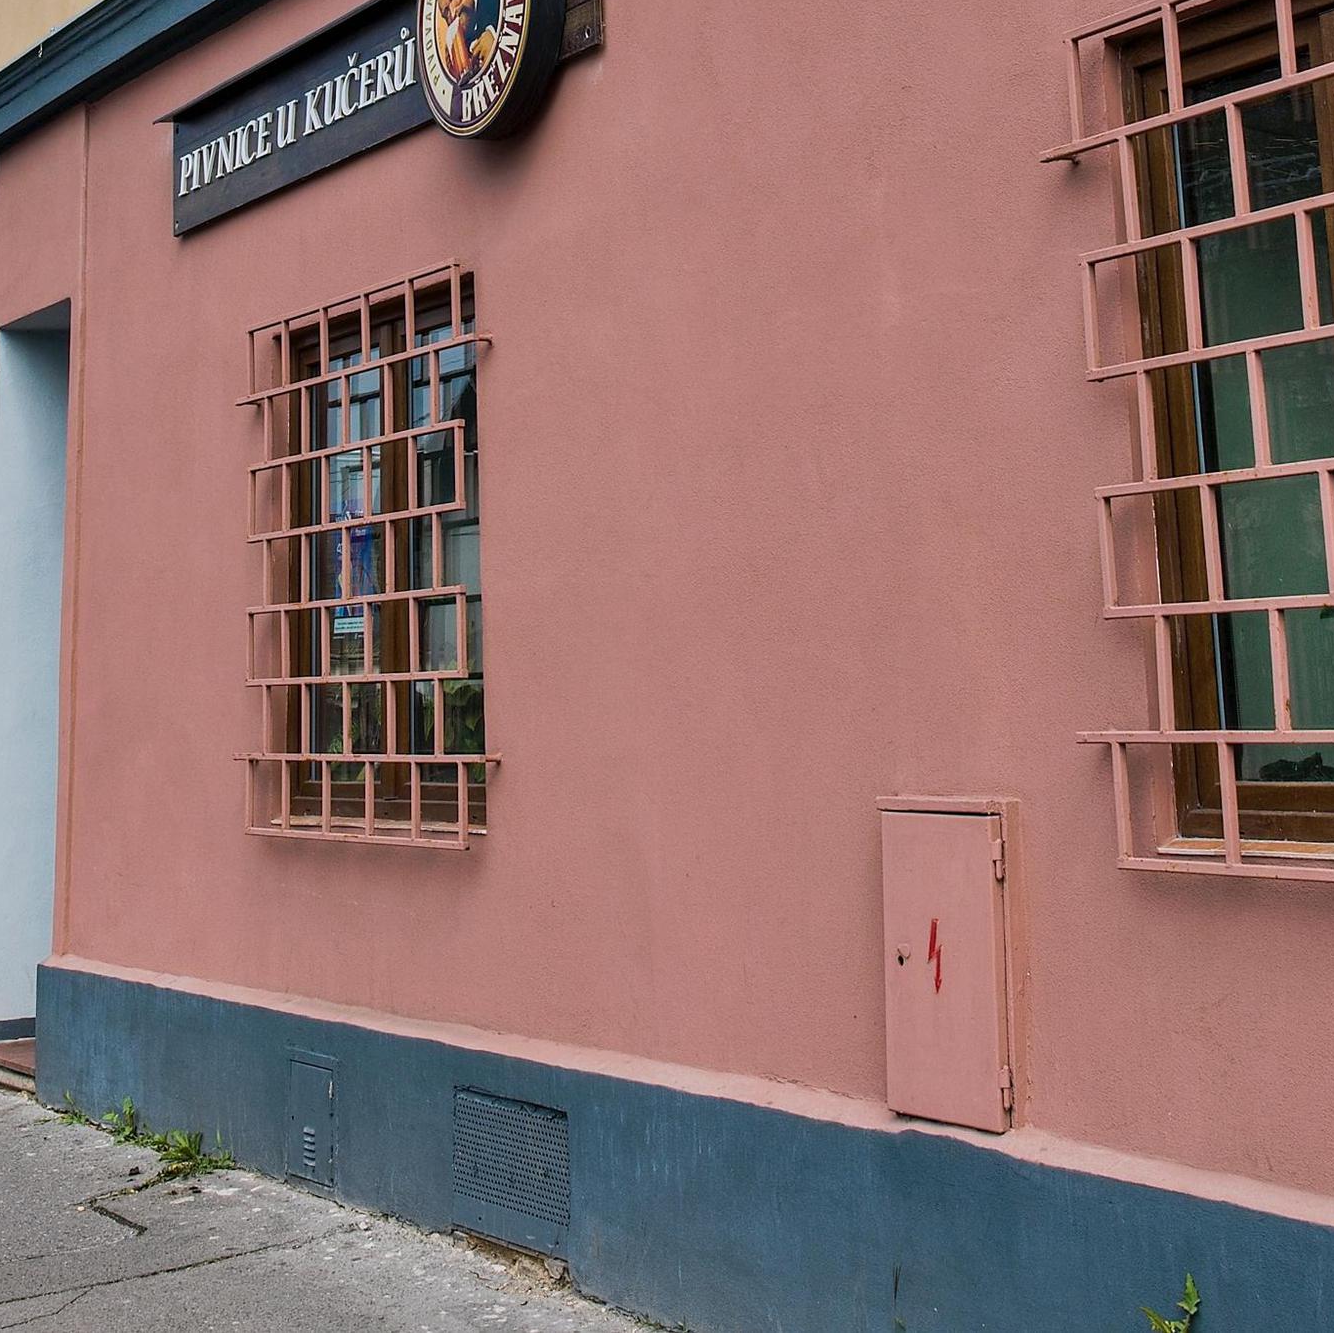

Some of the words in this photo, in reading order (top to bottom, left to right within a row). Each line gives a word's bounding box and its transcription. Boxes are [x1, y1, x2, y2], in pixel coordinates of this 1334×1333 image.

[178, 112, 273, 197] PIVNICE
[276, 99, 299, 149] U
[303, 27, 417, 136] KUČERŮ
